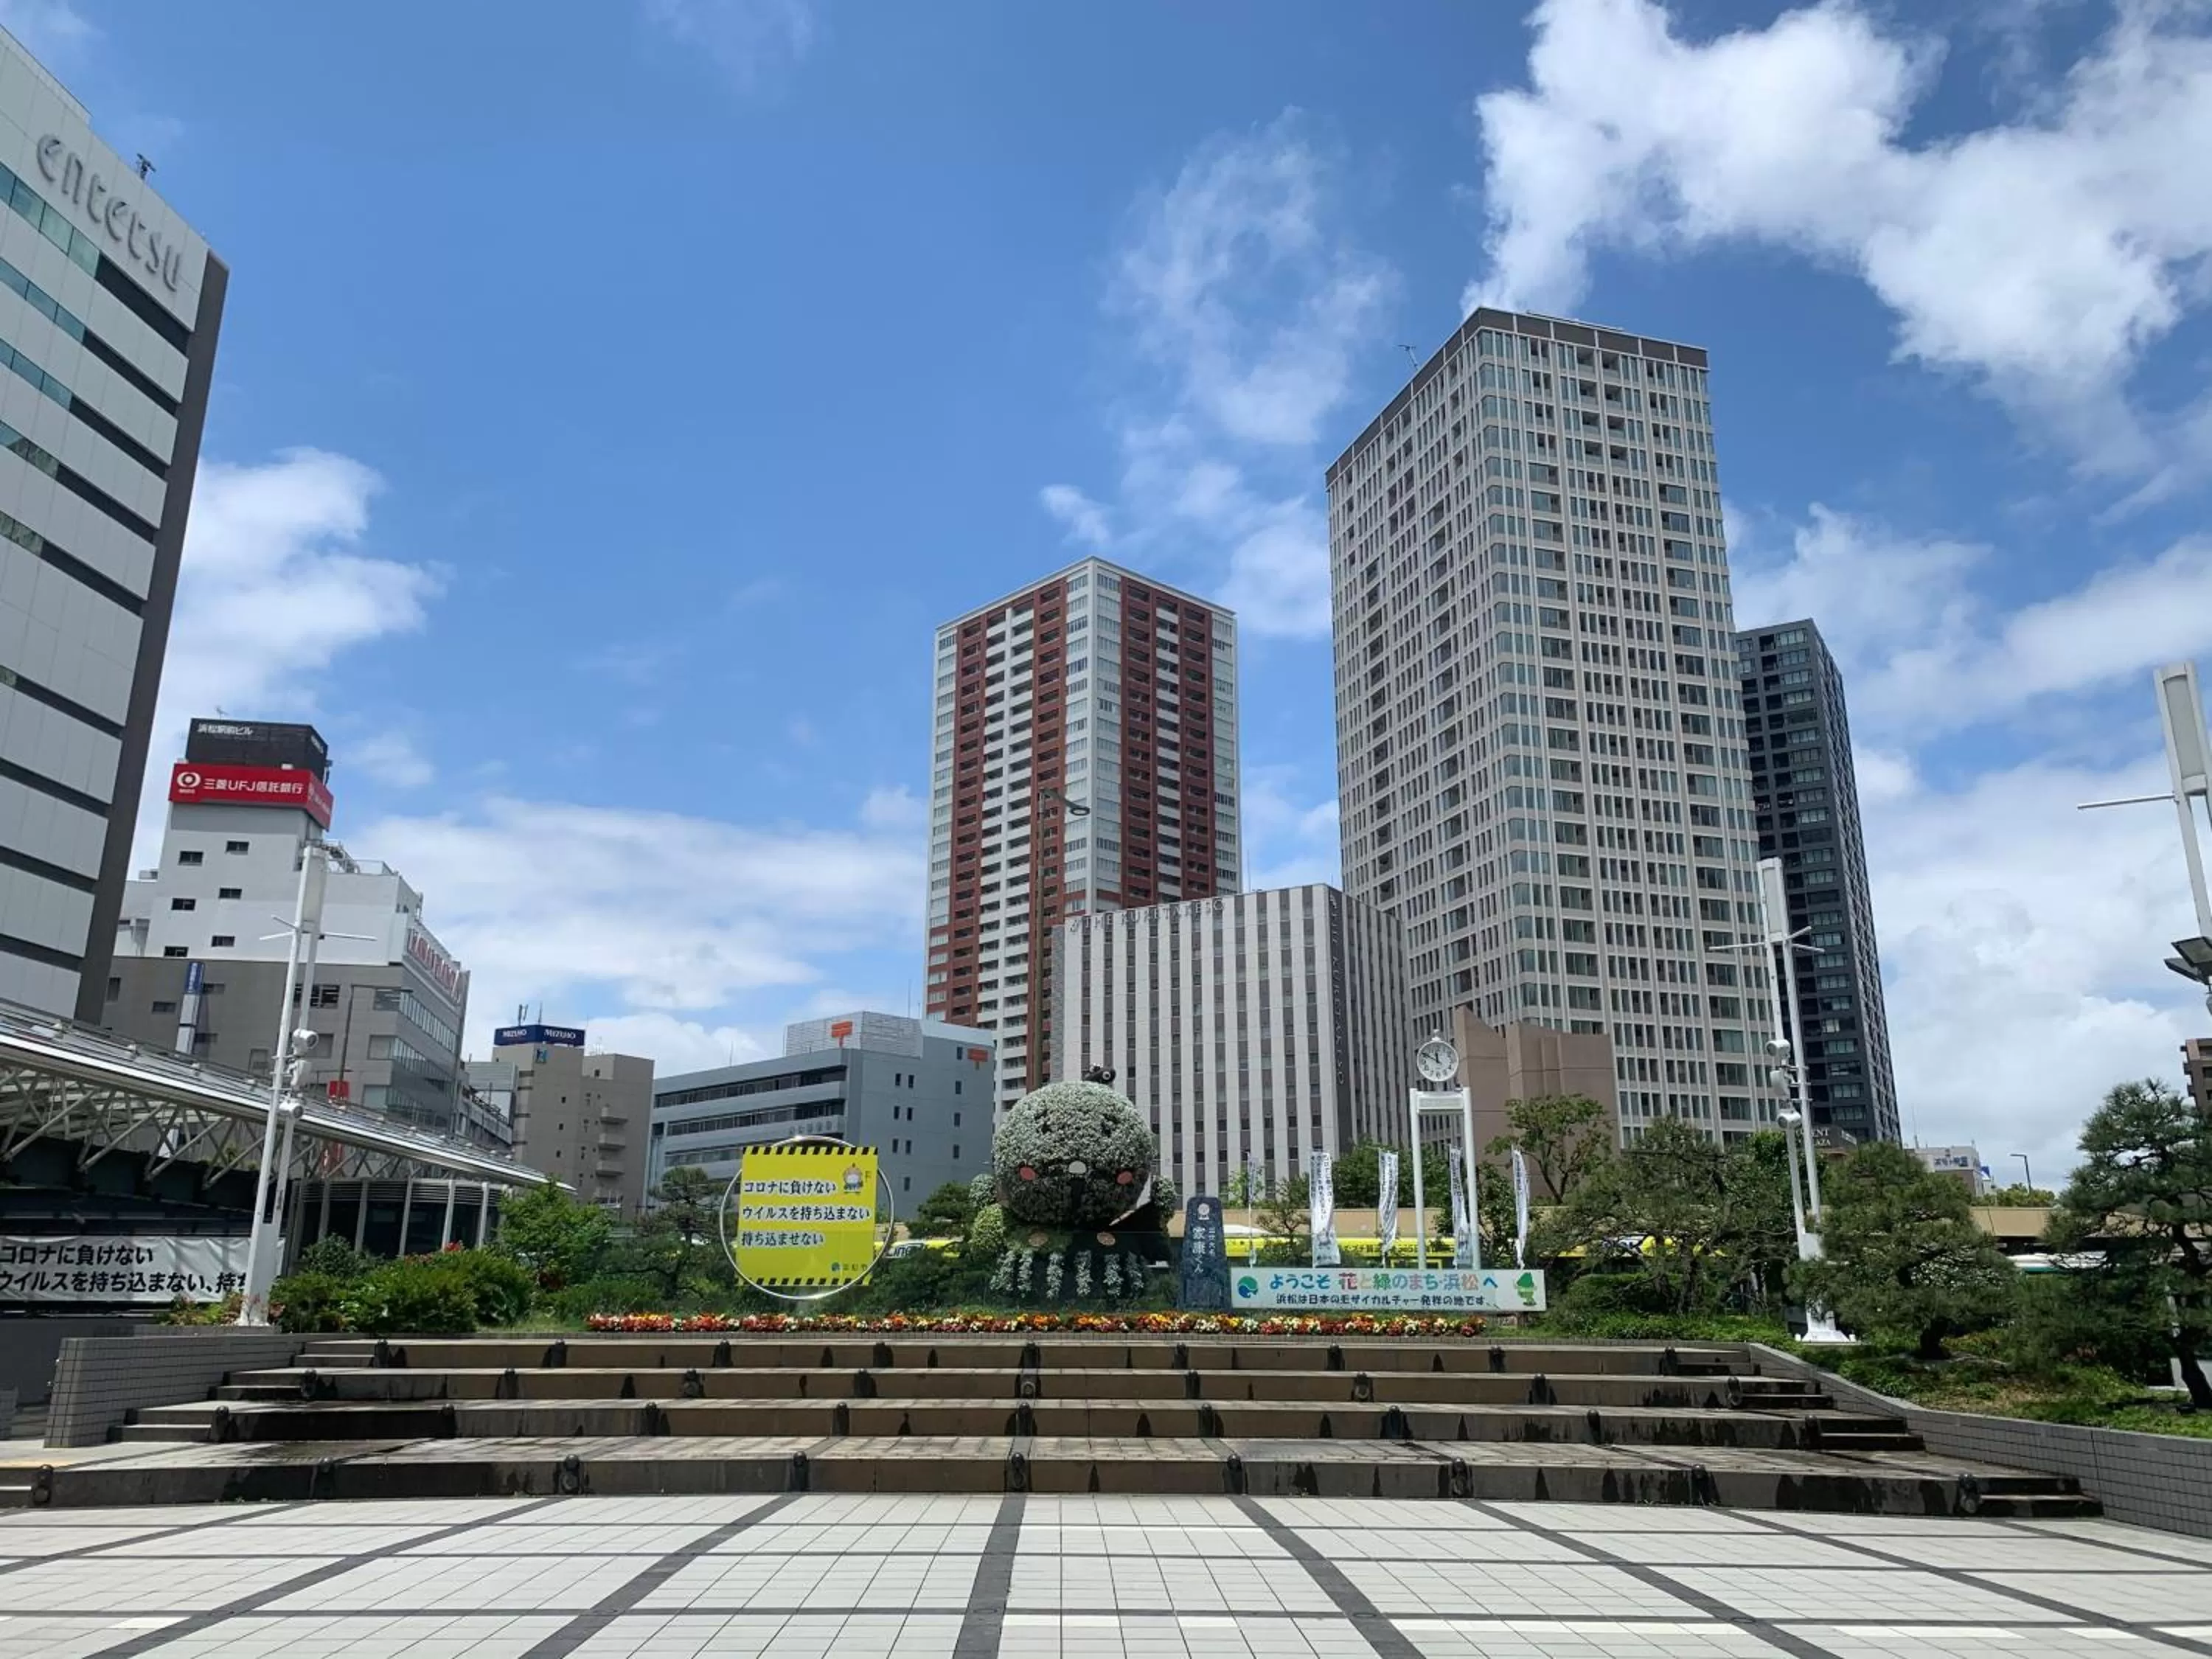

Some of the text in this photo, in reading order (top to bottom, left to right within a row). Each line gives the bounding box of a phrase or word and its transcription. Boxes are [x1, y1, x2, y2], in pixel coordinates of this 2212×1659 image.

[37, 134, 179, 292] entetsu
[204, 778, 304, 794] 三菱UFJ信託銀行
[544, 1029, 576, 1039] MIZUHO
[744, 1180, 836, 1194] コロナに負けない
[742, 1206, 870, 1220] ウイルスを持ち込まない
[741, 1232, 824, 1246] 持ち込ませない
[0, 1245, 153, 1265] コロナに負けない
[1270, 1273, 1330, 1290] ようこそ
